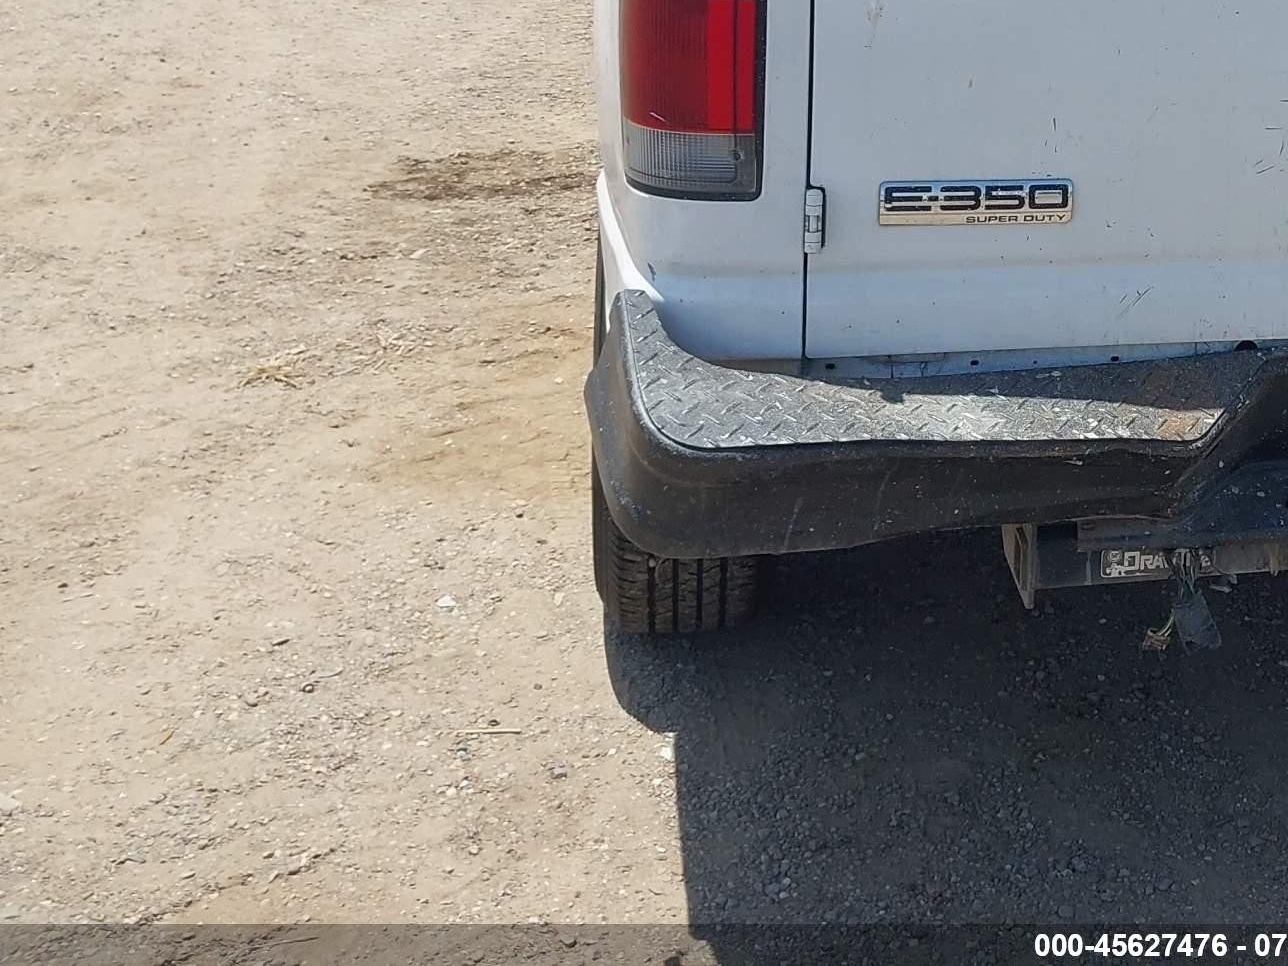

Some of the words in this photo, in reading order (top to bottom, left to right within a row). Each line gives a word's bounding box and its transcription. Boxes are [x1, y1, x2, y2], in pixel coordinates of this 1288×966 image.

[884, 183, 1069, 212] E-350
[965, 215, 1018, 224] SUPER
[1023, 213, 1066, 222] DUTY
